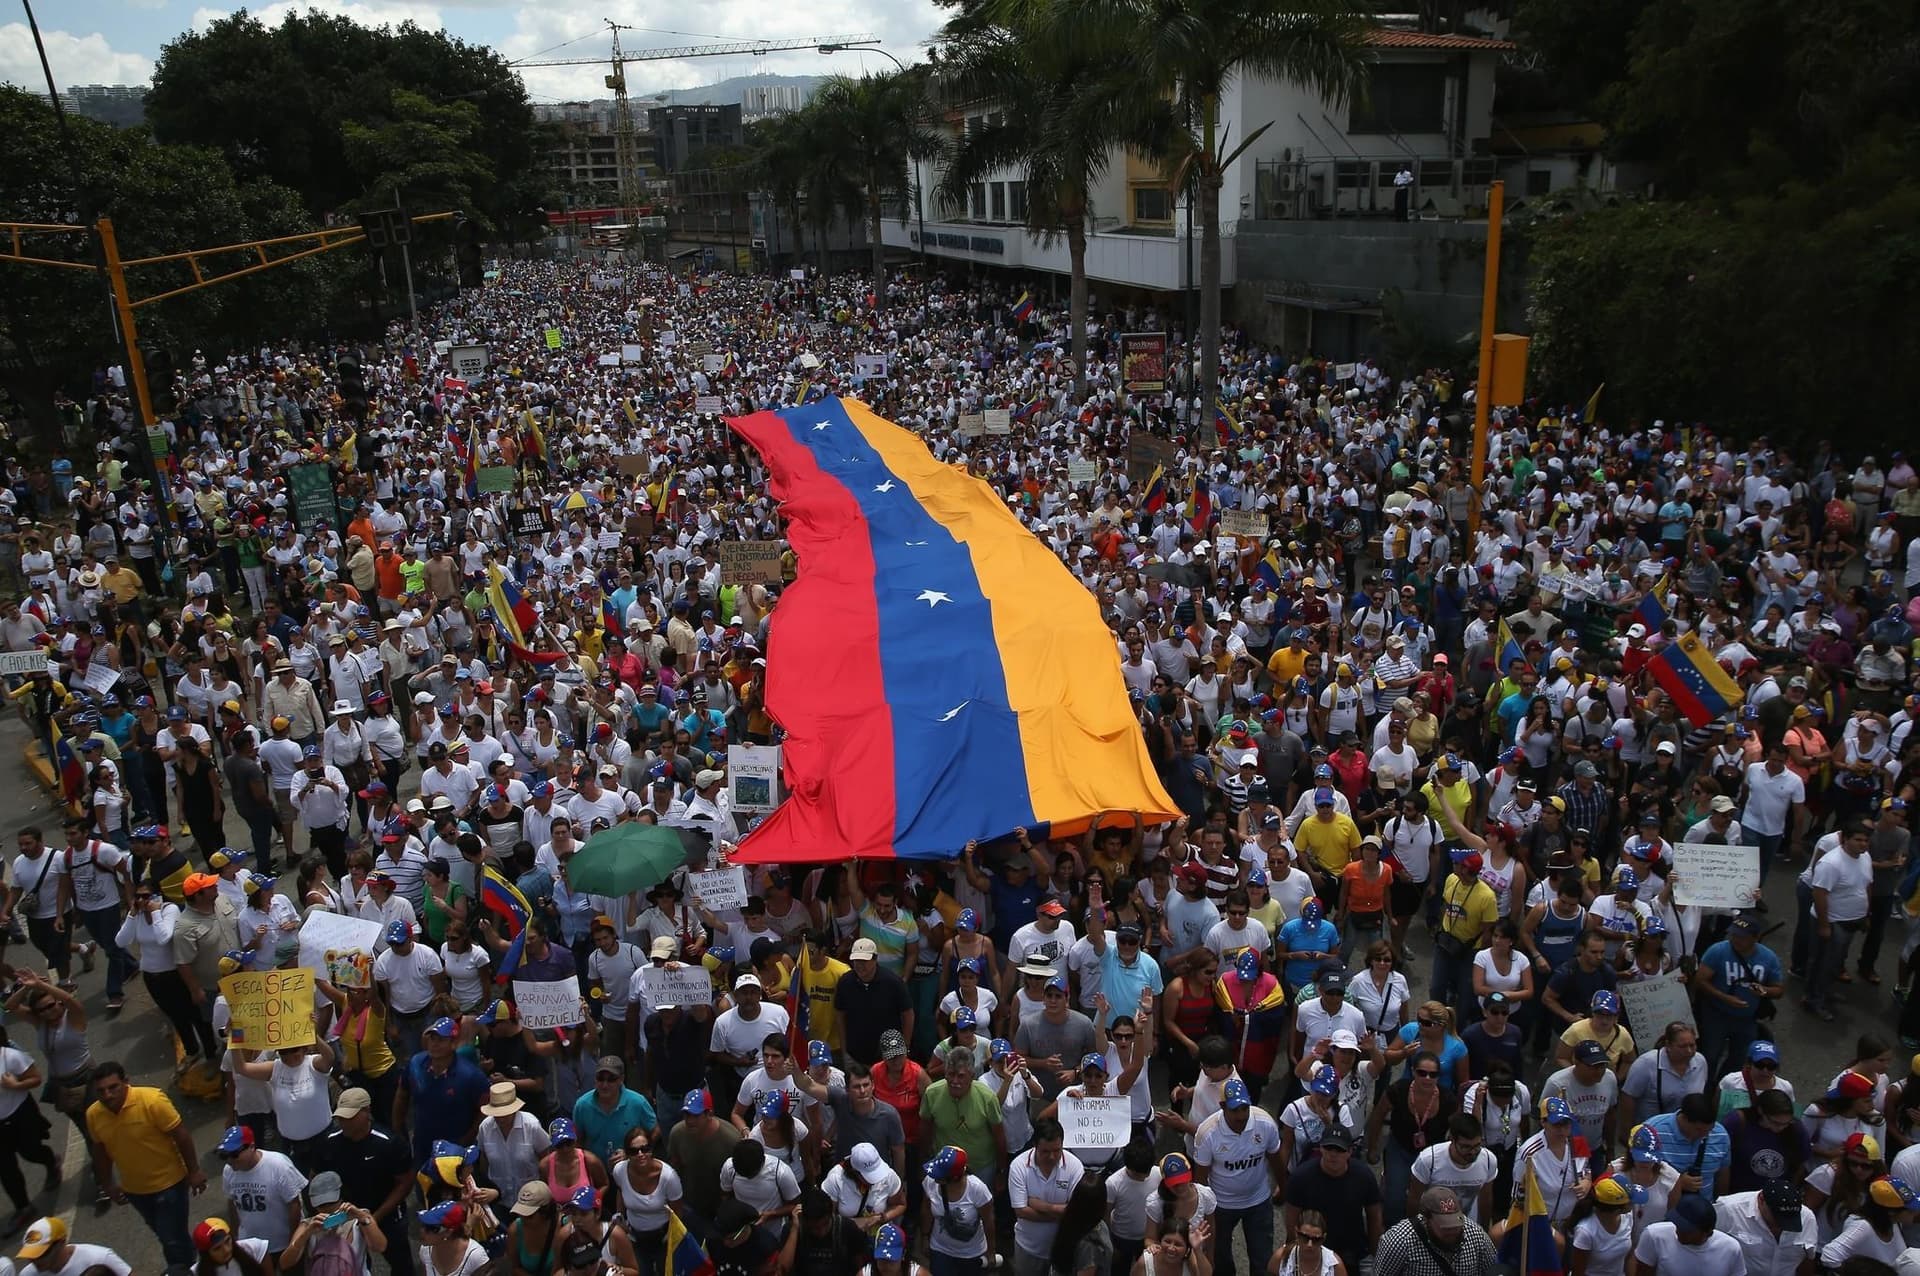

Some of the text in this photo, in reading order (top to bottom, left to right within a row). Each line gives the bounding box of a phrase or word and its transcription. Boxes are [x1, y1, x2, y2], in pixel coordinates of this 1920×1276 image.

[723, 543, 775, 553] VENEZUELA
[721, 554, 733, 562] EN
[722, 562, 733, 572] EL
[232, 974, 305, 995] ESCASEZ
[516, 992, 576, 1005] CARNAVAL
[669, 993, 683, 1003] LOS
[519, 1009, 585, 1028] VENEZUELA
[1073, 1099, 1111, 1111] INFORMAR
[1077, 1117, 1103, 1127] NO ES
[1074, 1132, 1114, 1144] UN DELITO
